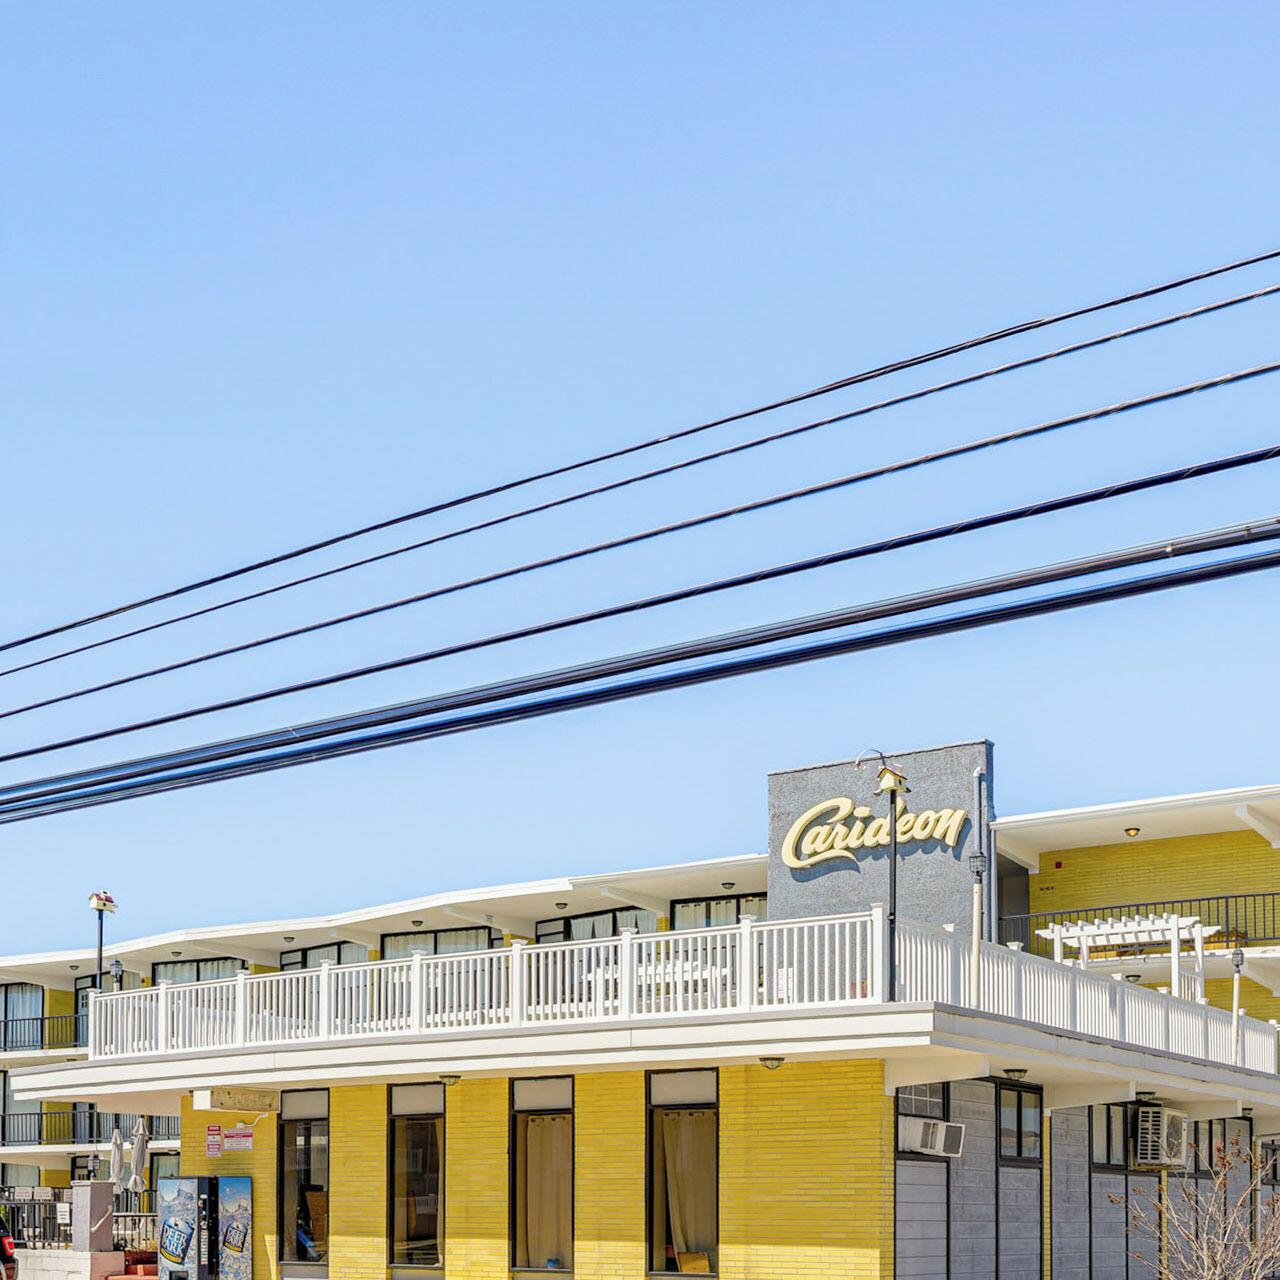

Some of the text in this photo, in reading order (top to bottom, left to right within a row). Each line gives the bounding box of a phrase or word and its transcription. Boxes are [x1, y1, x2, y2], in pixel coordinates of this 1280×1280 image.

[781, 797, 967, 868] Carideon
[163, 1223, 187, 1247] DEER
[161, 1239, 186, 1257] PARK
